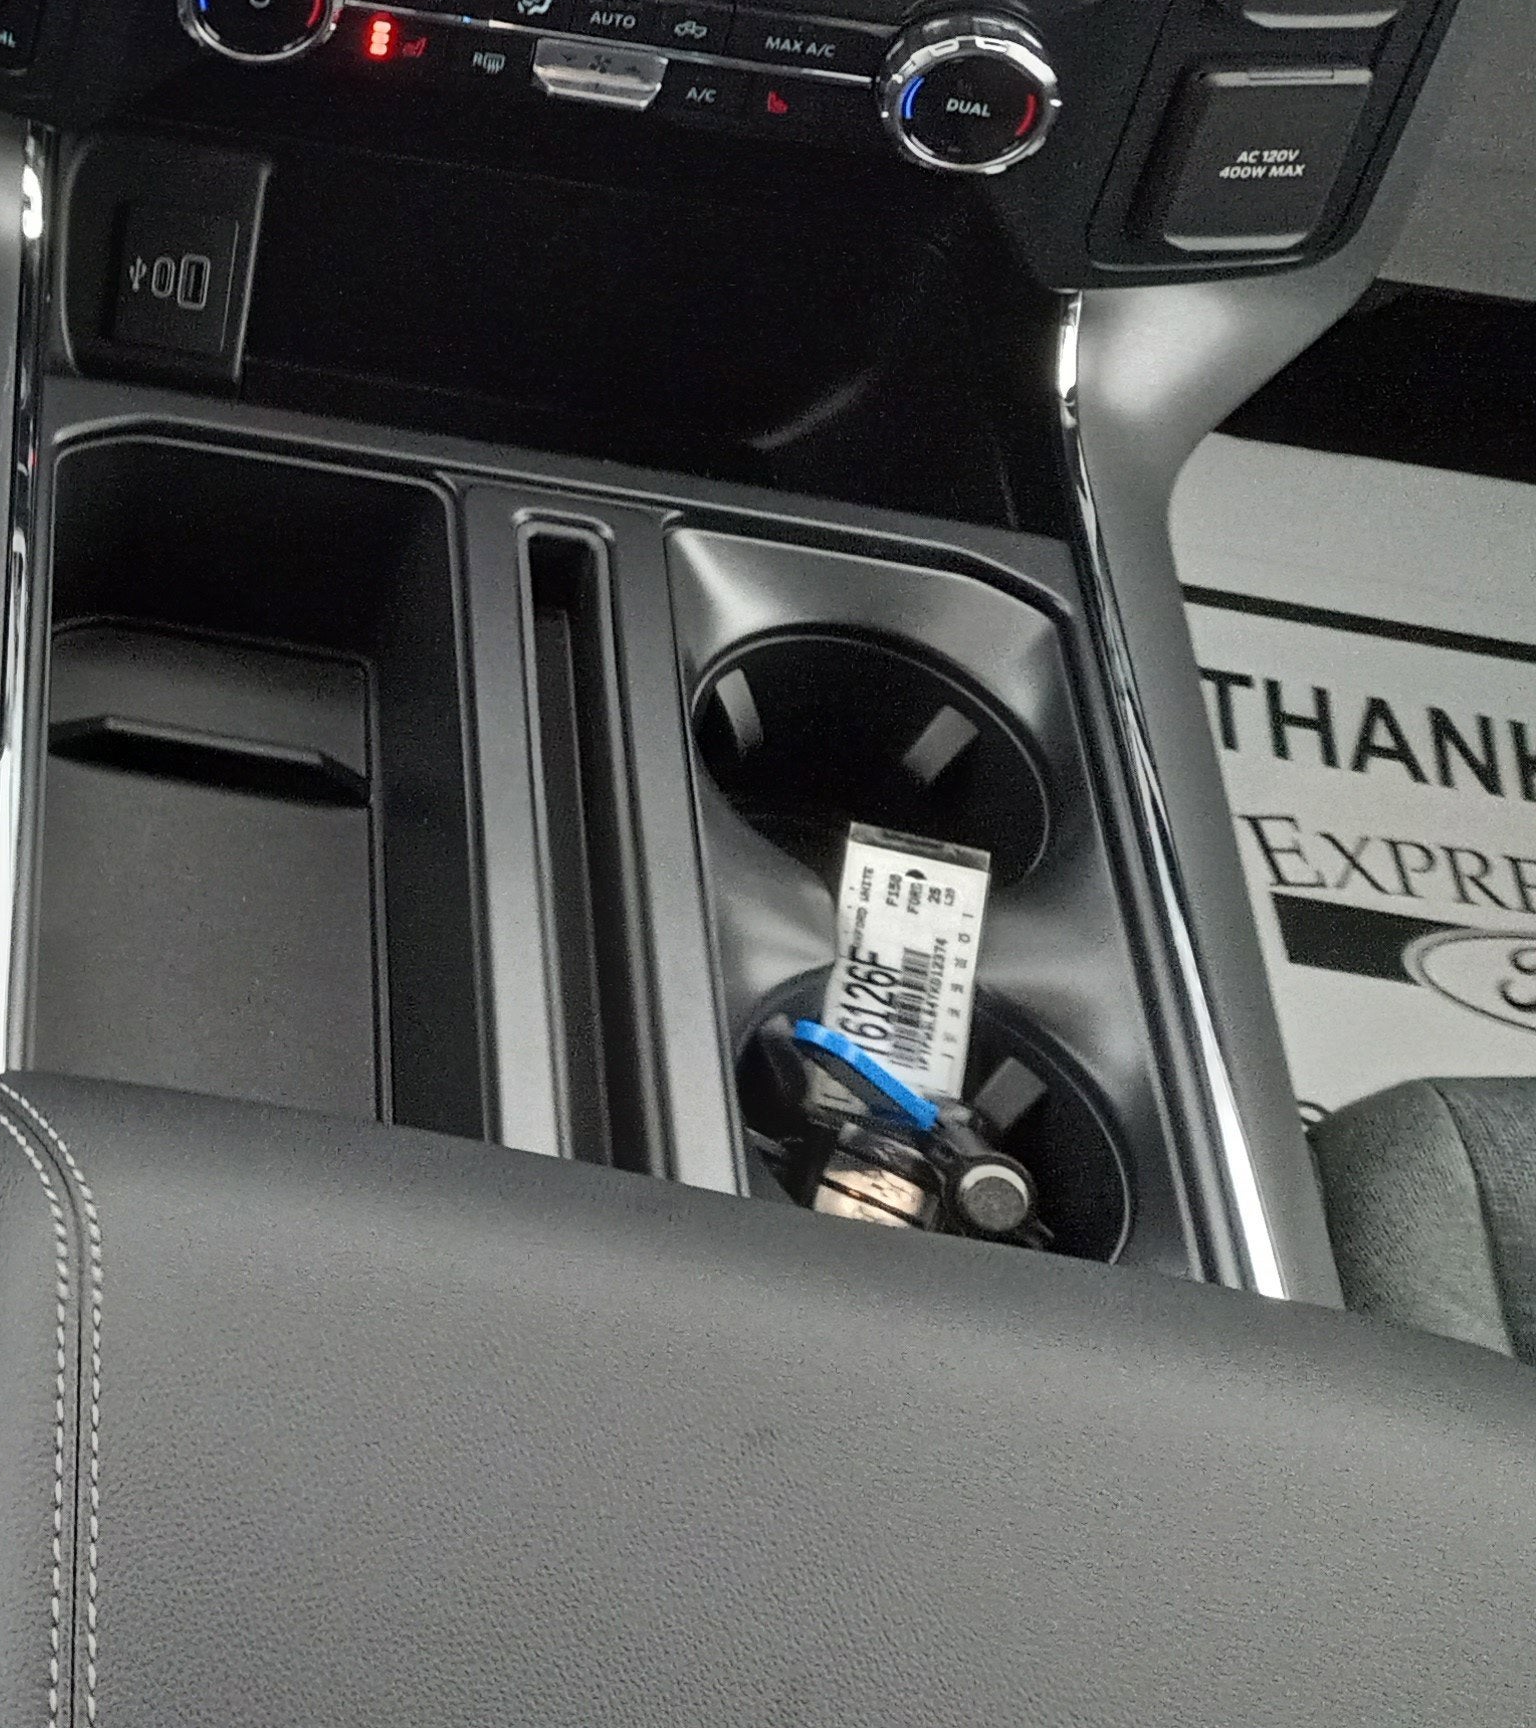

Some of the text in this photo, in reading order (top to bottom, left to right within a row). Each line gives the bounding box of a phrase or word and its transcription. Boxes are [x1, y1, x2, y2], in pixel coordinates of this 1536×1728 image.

[589, 9, 637, 30] AUTO
[765, 35, 837, 58] MAX A/C
[686, 85, 717, 104] A/C
[945, 97, 992, 119] DUAL
[1236, 149, 1300, 164] AC 120V
[1218, 163, 1306, 179] 400W MAX
[859, 865, 874, 903] WHITE
[885, 873, 903, 908] F150
